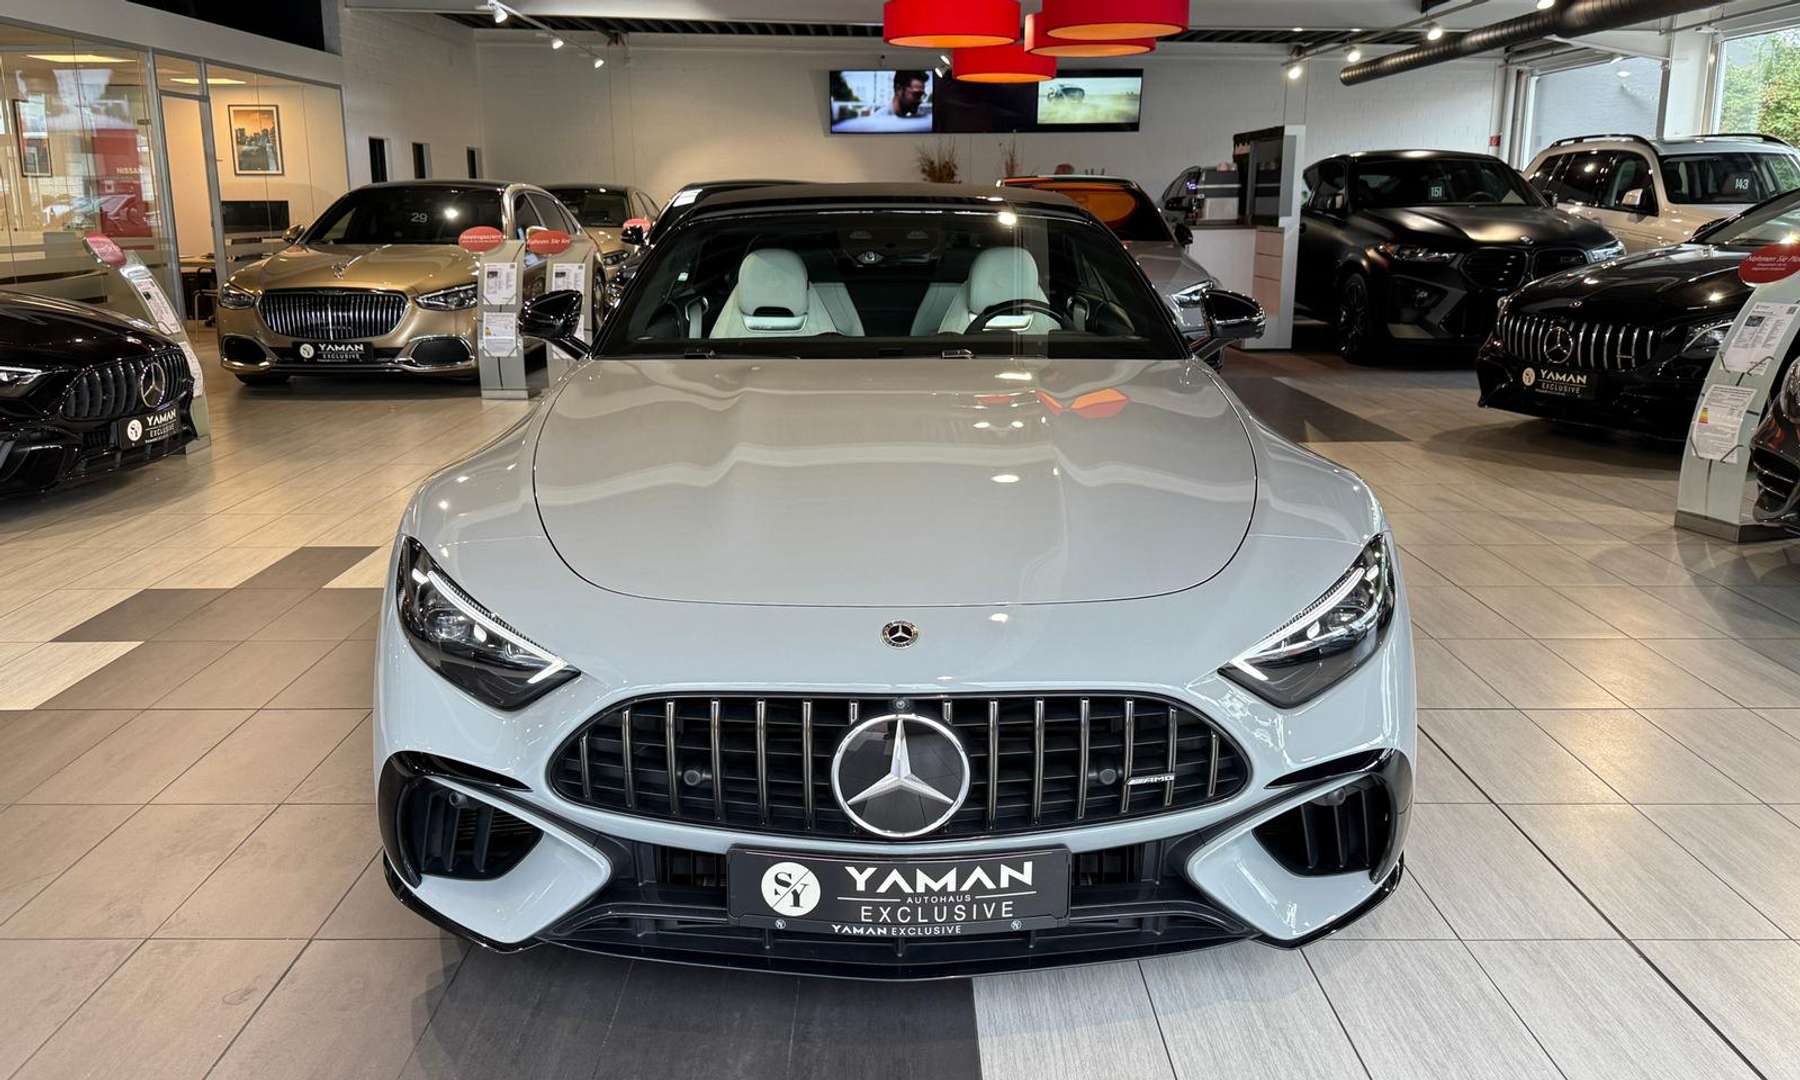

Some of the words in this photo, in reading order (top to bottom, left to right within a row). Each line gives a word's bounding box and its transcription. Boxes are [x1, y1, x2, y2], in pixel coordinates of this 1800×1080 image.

[411, 212, 428, 223] 29
[318, 343, 364, 352] YAMAN
[1540, 369, 1587, 385] YAMAN
[146, 408, 177, 426] YAMAN
[844, 861, 1033, 894] YAMAN
[906, 894, 971, 904] AUTOHAUS
[861, 901, 1014, 923] EXCLUSIVE
[832, 924, 887, 936] YAMAN
[891, 925, 961, 936] EXCLUSIVE
